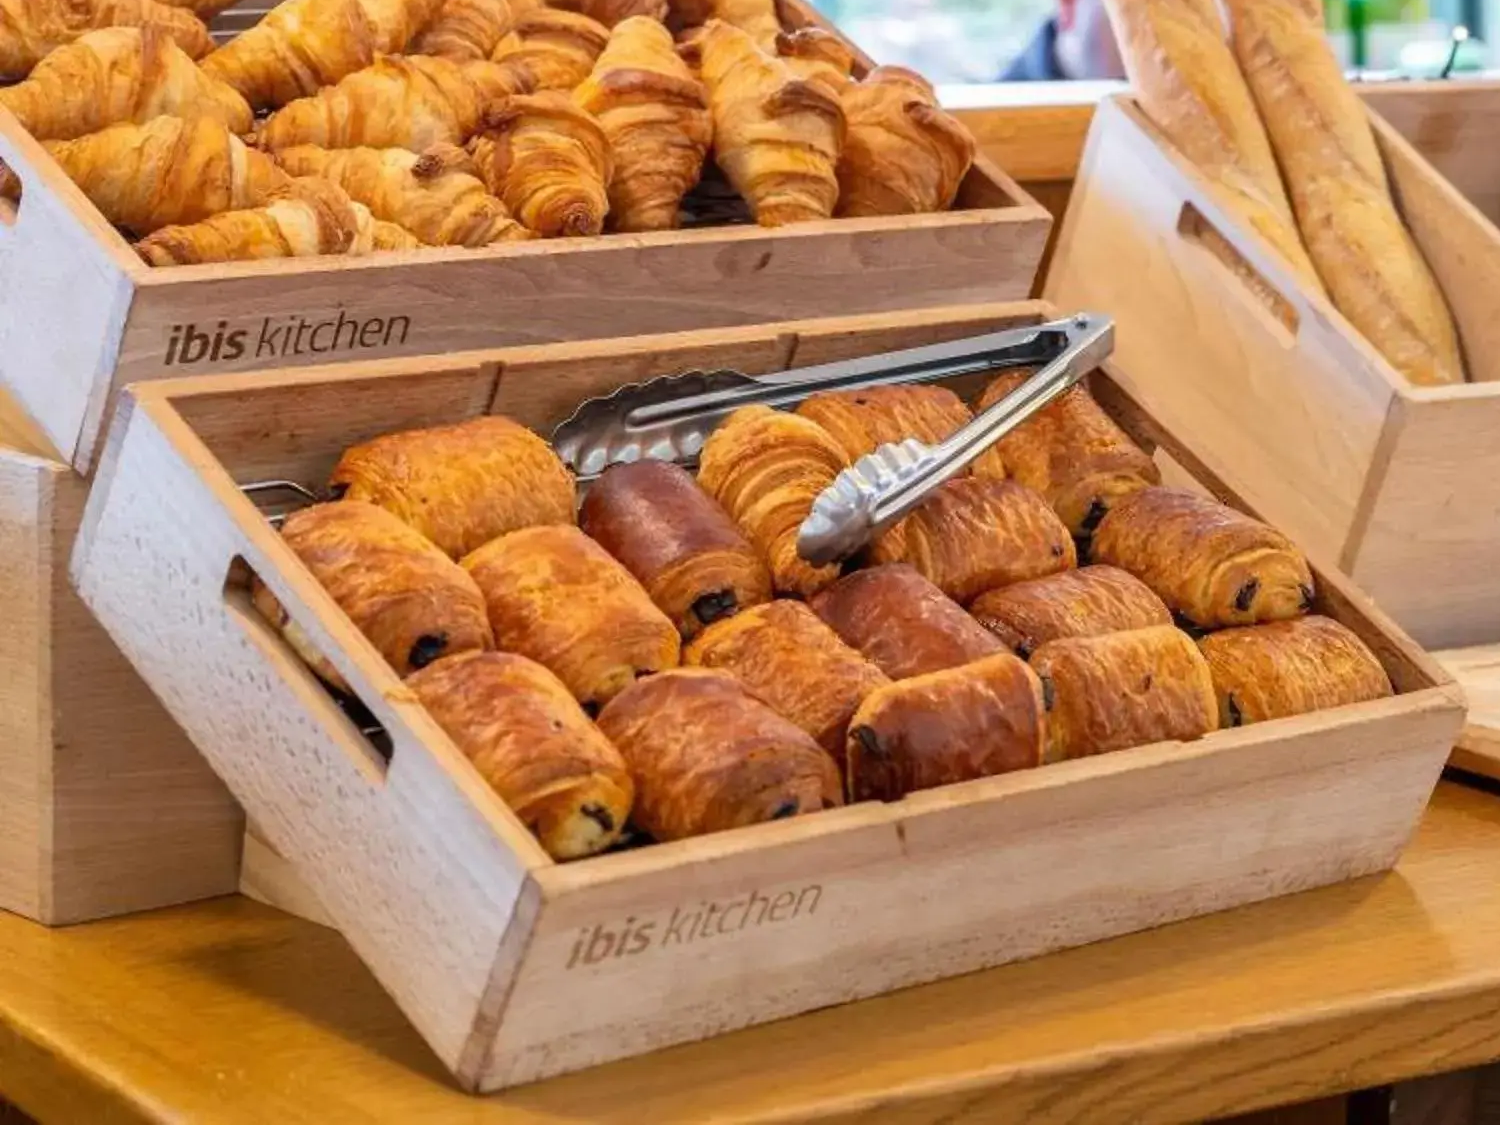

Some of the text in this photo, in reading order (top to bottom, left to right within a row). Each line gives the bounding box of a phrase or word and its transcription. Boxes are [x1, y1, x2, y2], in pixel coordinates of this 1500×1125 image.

[164, 311, 410, 365] ibis kitchen
[566, 884, 823, 969] ibis kitchen
